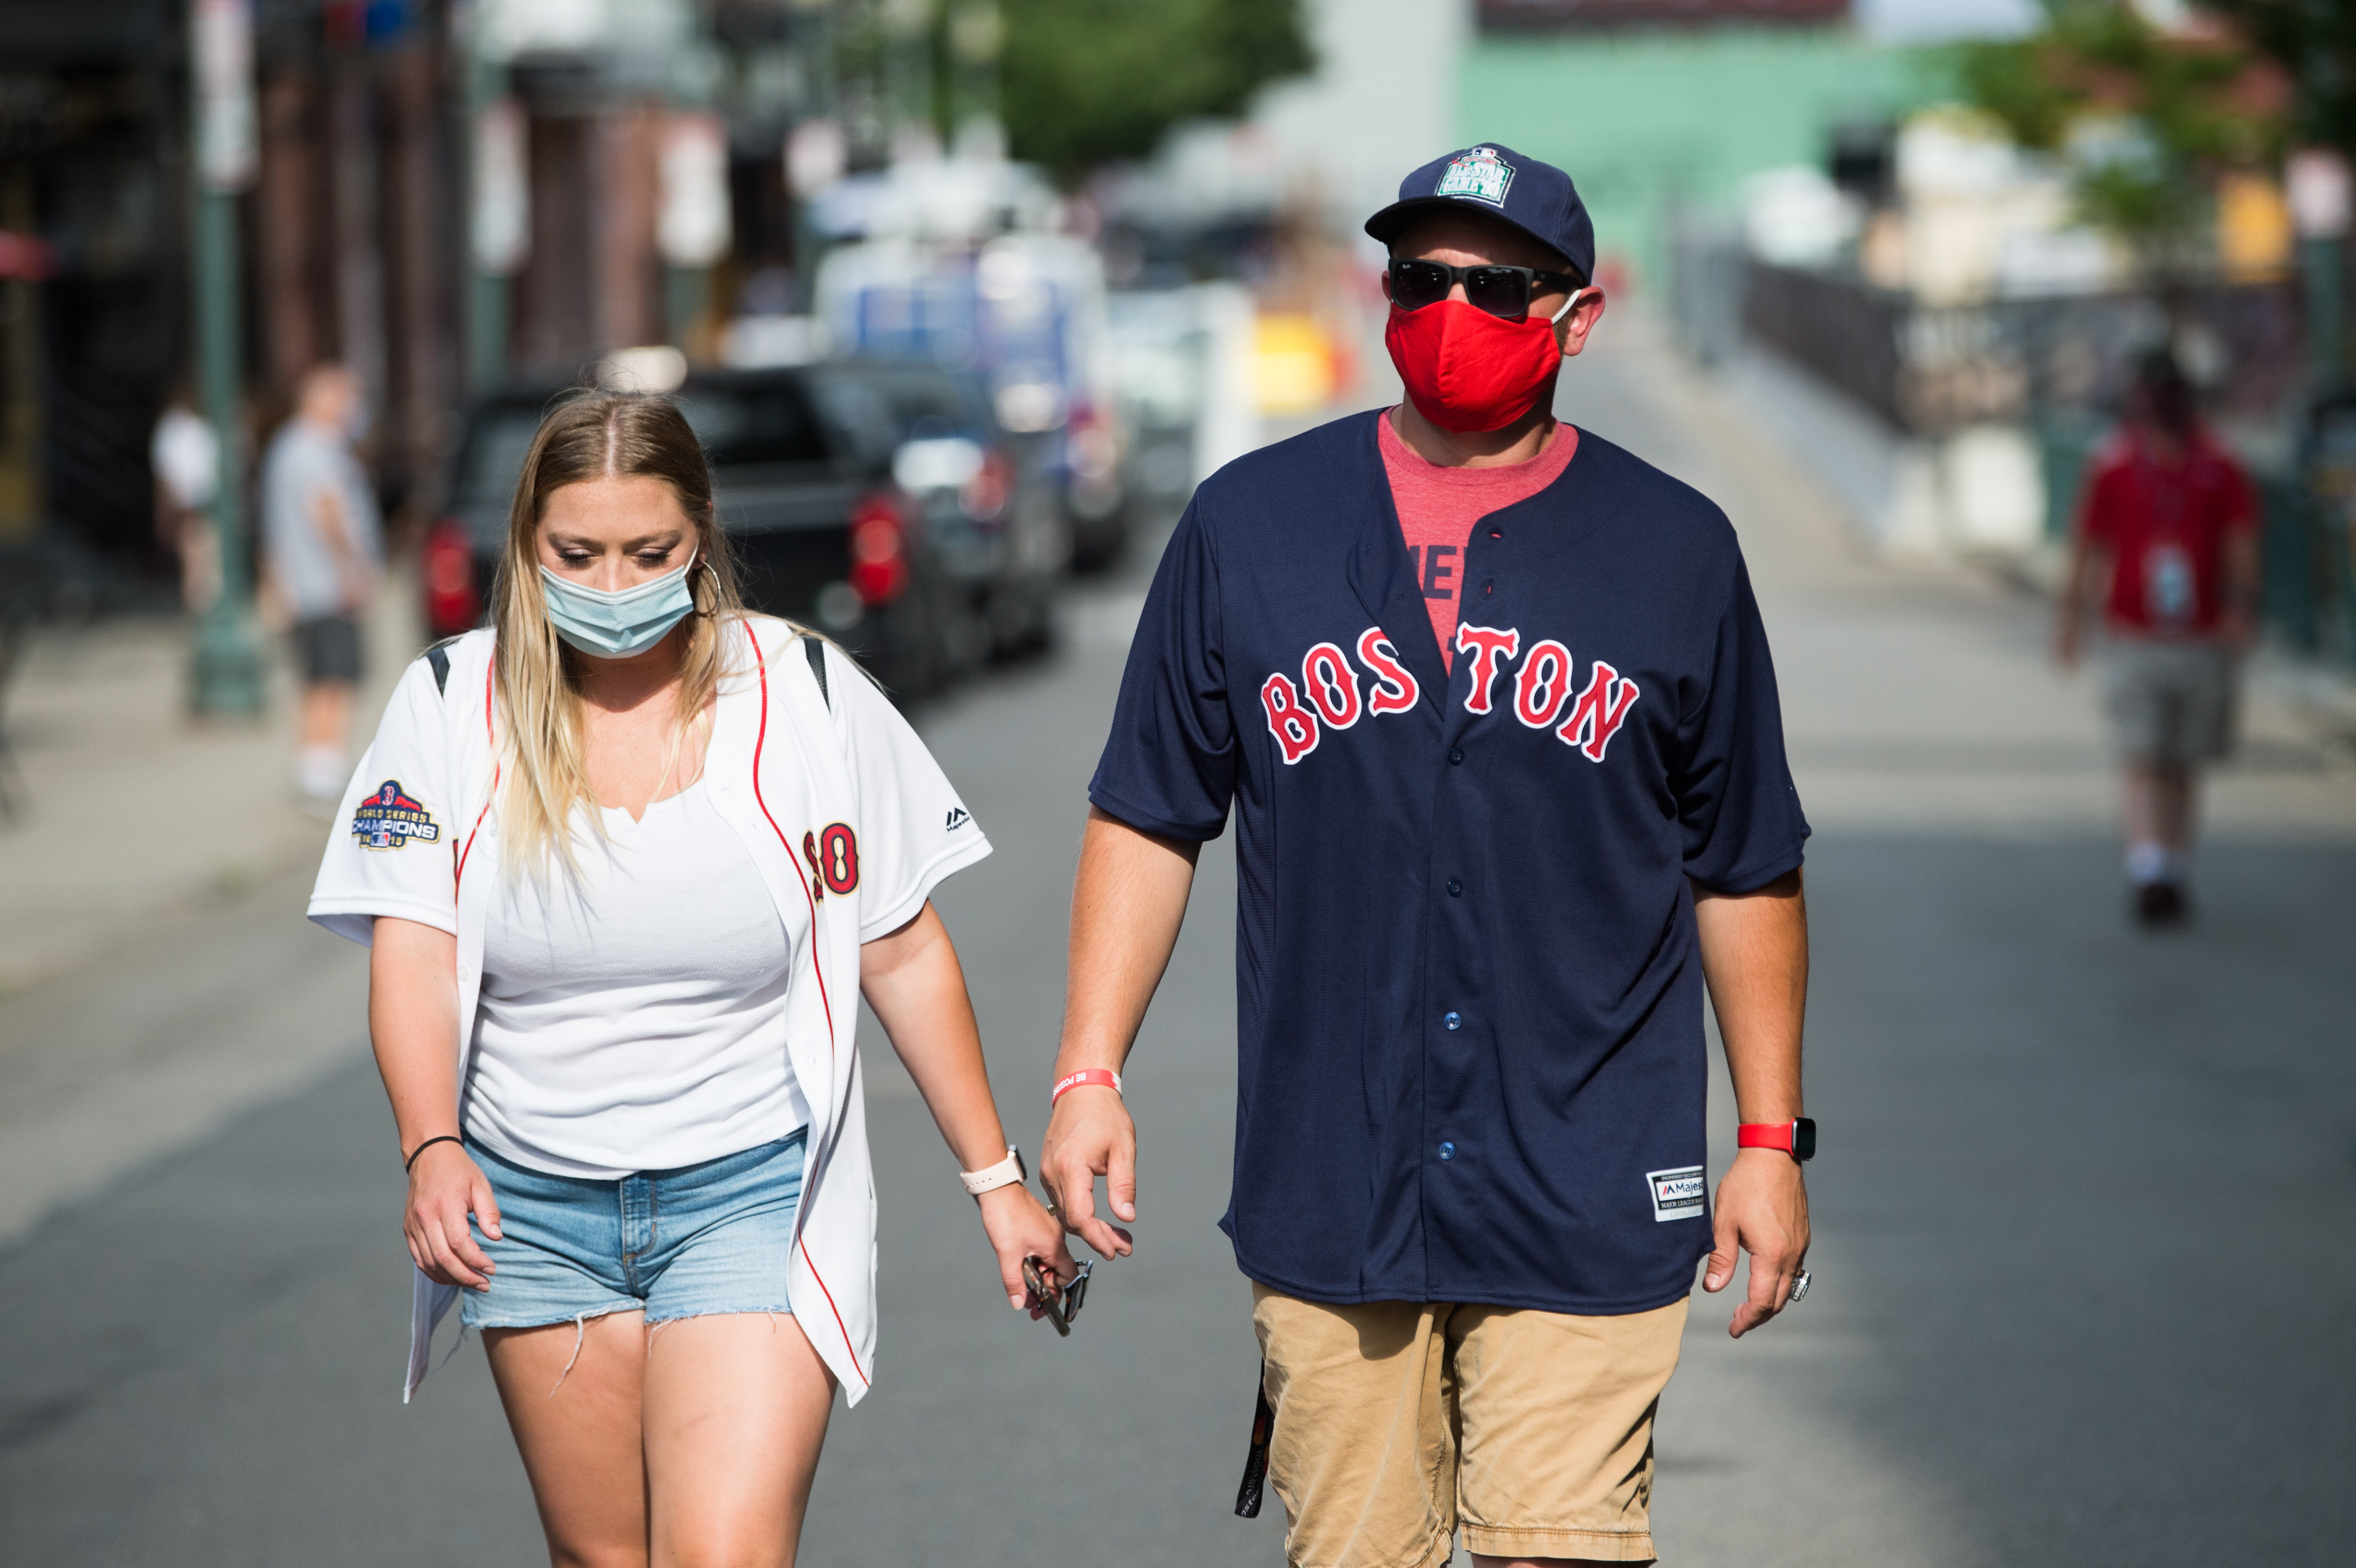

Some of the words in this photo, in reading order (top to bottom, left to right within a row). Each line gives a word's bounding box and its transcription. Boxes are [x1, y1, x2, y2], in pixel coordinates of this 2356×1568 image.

[1442, 175, 1478, 193] GAME
[1260, 621, 1640, 766] BOSTON
[357, 808, 384, 819] WORLD
[385, 809, 428, 823] SERIES
[352, 819, 436, 840] CHAMPIONS
[946, 816, 970, 833] Majestic
[1075, 1072, 1086, 1083] BE
[1678, 1199, 1695, 1207] LEAGUE
